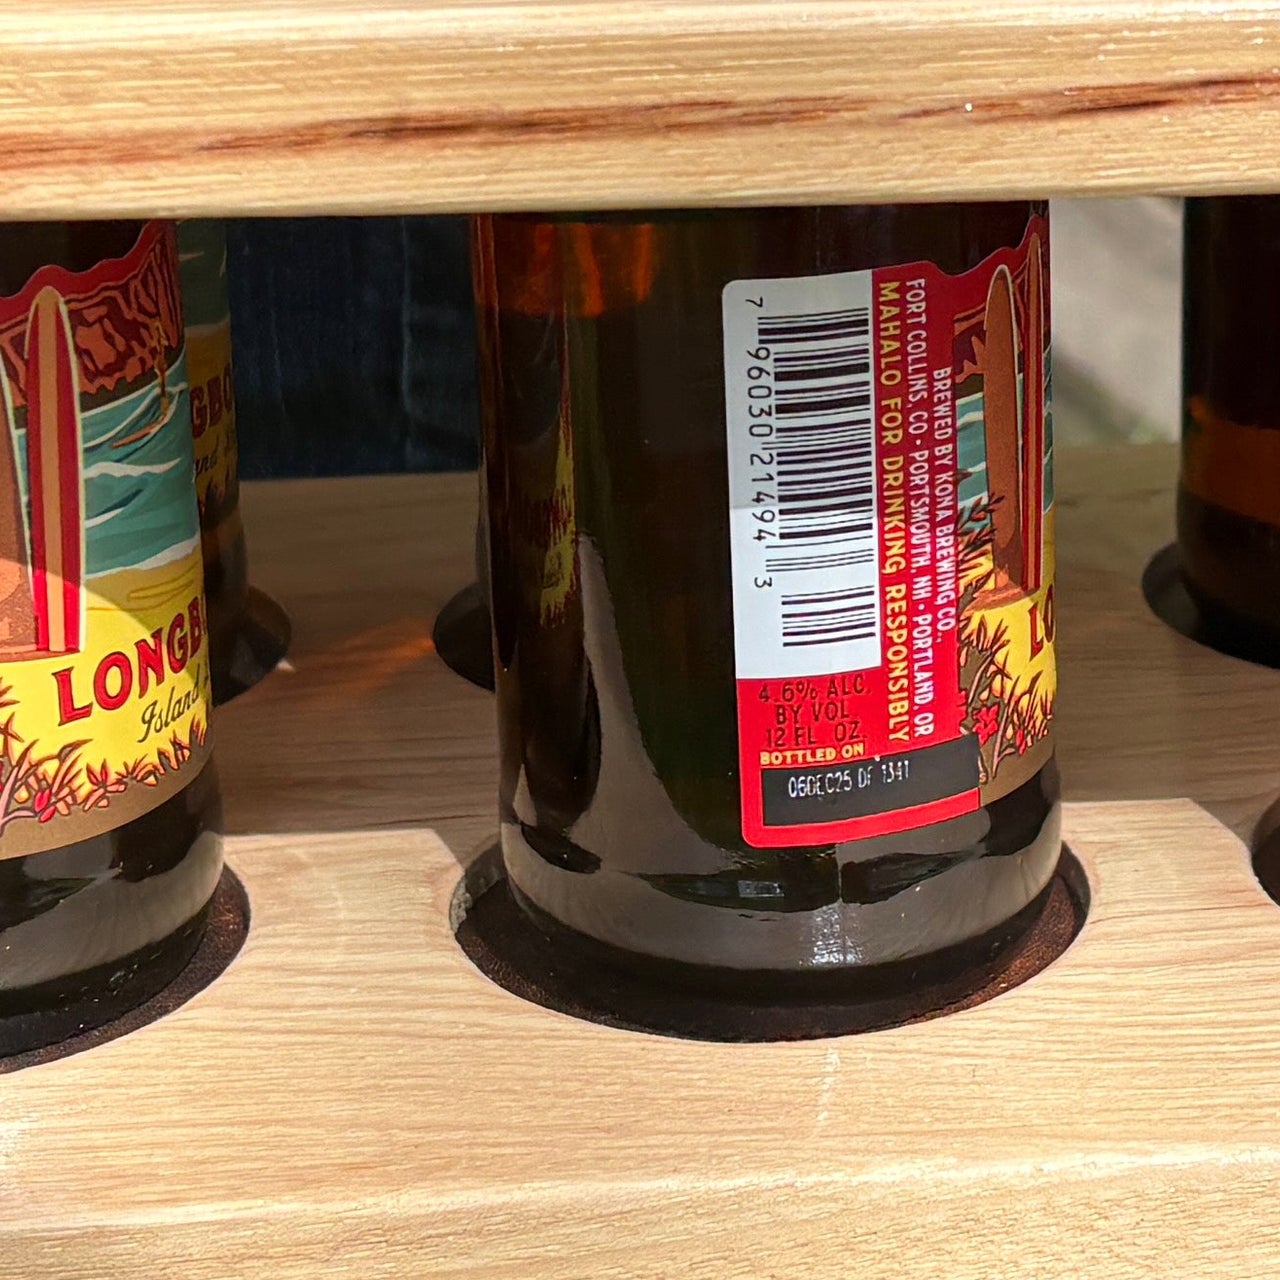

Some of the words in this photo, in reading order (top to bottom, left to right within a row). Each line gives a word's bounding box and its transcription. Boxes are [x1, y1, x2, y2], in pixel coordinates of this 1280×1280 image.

[745, 296, 763, 308] 7
[906, 278, 926, 324] FORT
[879, 282, 901, 385] MAHALO
[746, 347, 773, 438] 96030
[933, 367, 952, 440] BREWED
[881, 397, 903, 445] FOR
[909, 412, 928, 434] CO
[934, 445, 953, 465] BY
[750, 452, 777, 542] 21494
[882, 456, 907, 574] DRINKING
[935, 471, 954, 521] KONA
[754, 576, 772, 588] 3
[934, 523, 956, 605] BREWING
[912, 576, 932, 600] NH
[51, 596, 206, 726] LONGB
[885, 583, 909, 742] RESPONSIBLY
[137, 663, 200, 743] Island
[759, 681, 818, 703] 4.6%
[776, 705, 802, 725] BY
[766, 726, 786, 748] 12
[914, 713, 934, 737] OR
[760, 746, 837, 766] BOTTLED
[841, 742, 864, 758] ON
